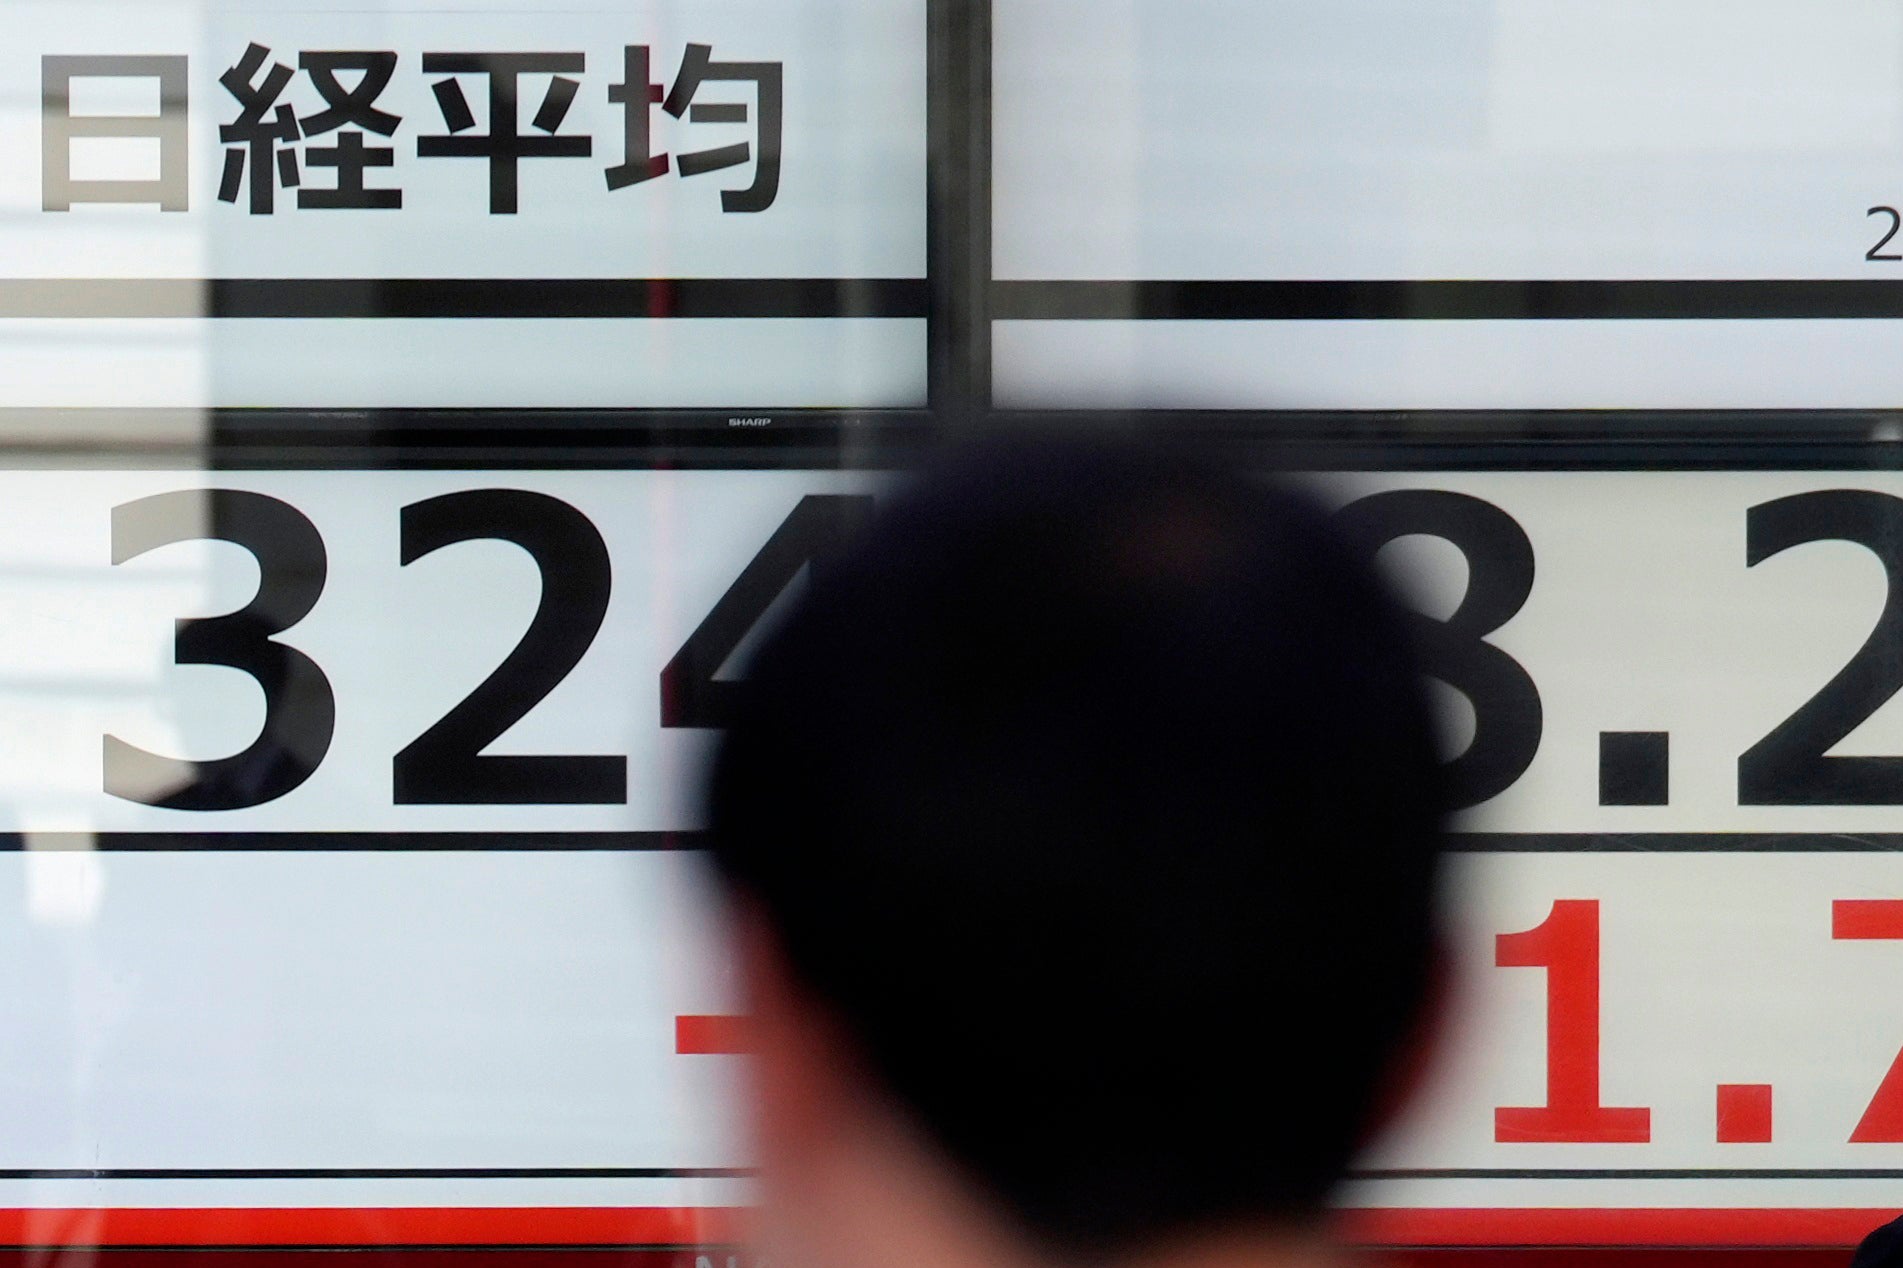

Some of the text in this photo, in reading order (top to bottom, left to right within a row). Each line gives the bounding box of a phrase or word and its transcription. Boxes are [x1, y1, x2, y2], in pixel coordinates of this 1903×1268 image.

[41, 42, 783, 215] 日経平均
[728, 418, 772, 427] SHARP
